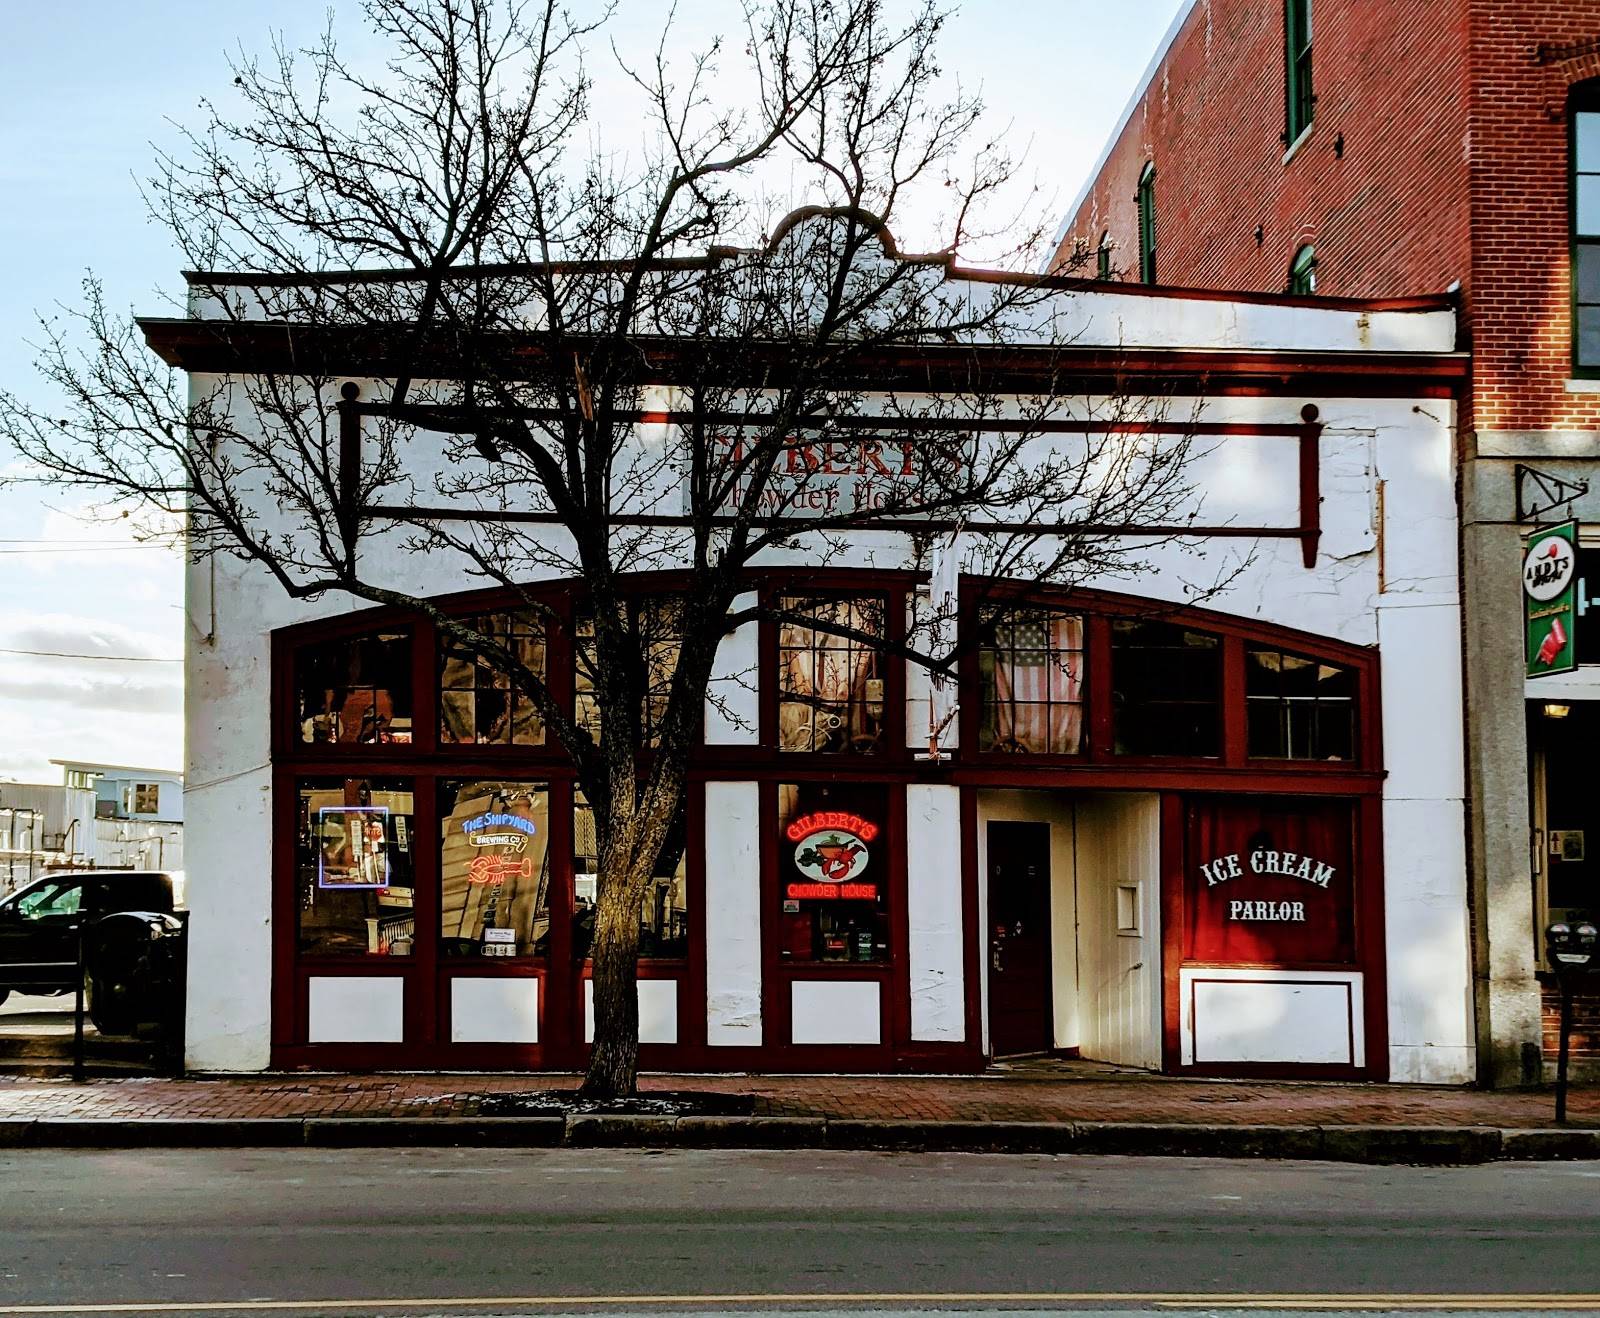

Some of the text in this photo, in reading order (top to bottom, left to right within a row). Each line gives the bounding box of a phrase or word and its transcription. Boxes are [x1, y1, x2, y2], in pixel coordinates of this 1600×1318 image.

[710, 480, 839, 511] hwder
[462, 812, 535, 835] THE SHIPYARD
[787, 812, 877, 841] GILBERT'S
[476, 836, 509, 845] BREWING
[1200, 850, 1336, 888] ICE CREAM
[788, 884, 876, 898] CHOWDER HOUSE
[1230, 900, 1305, 921] PARLOR
